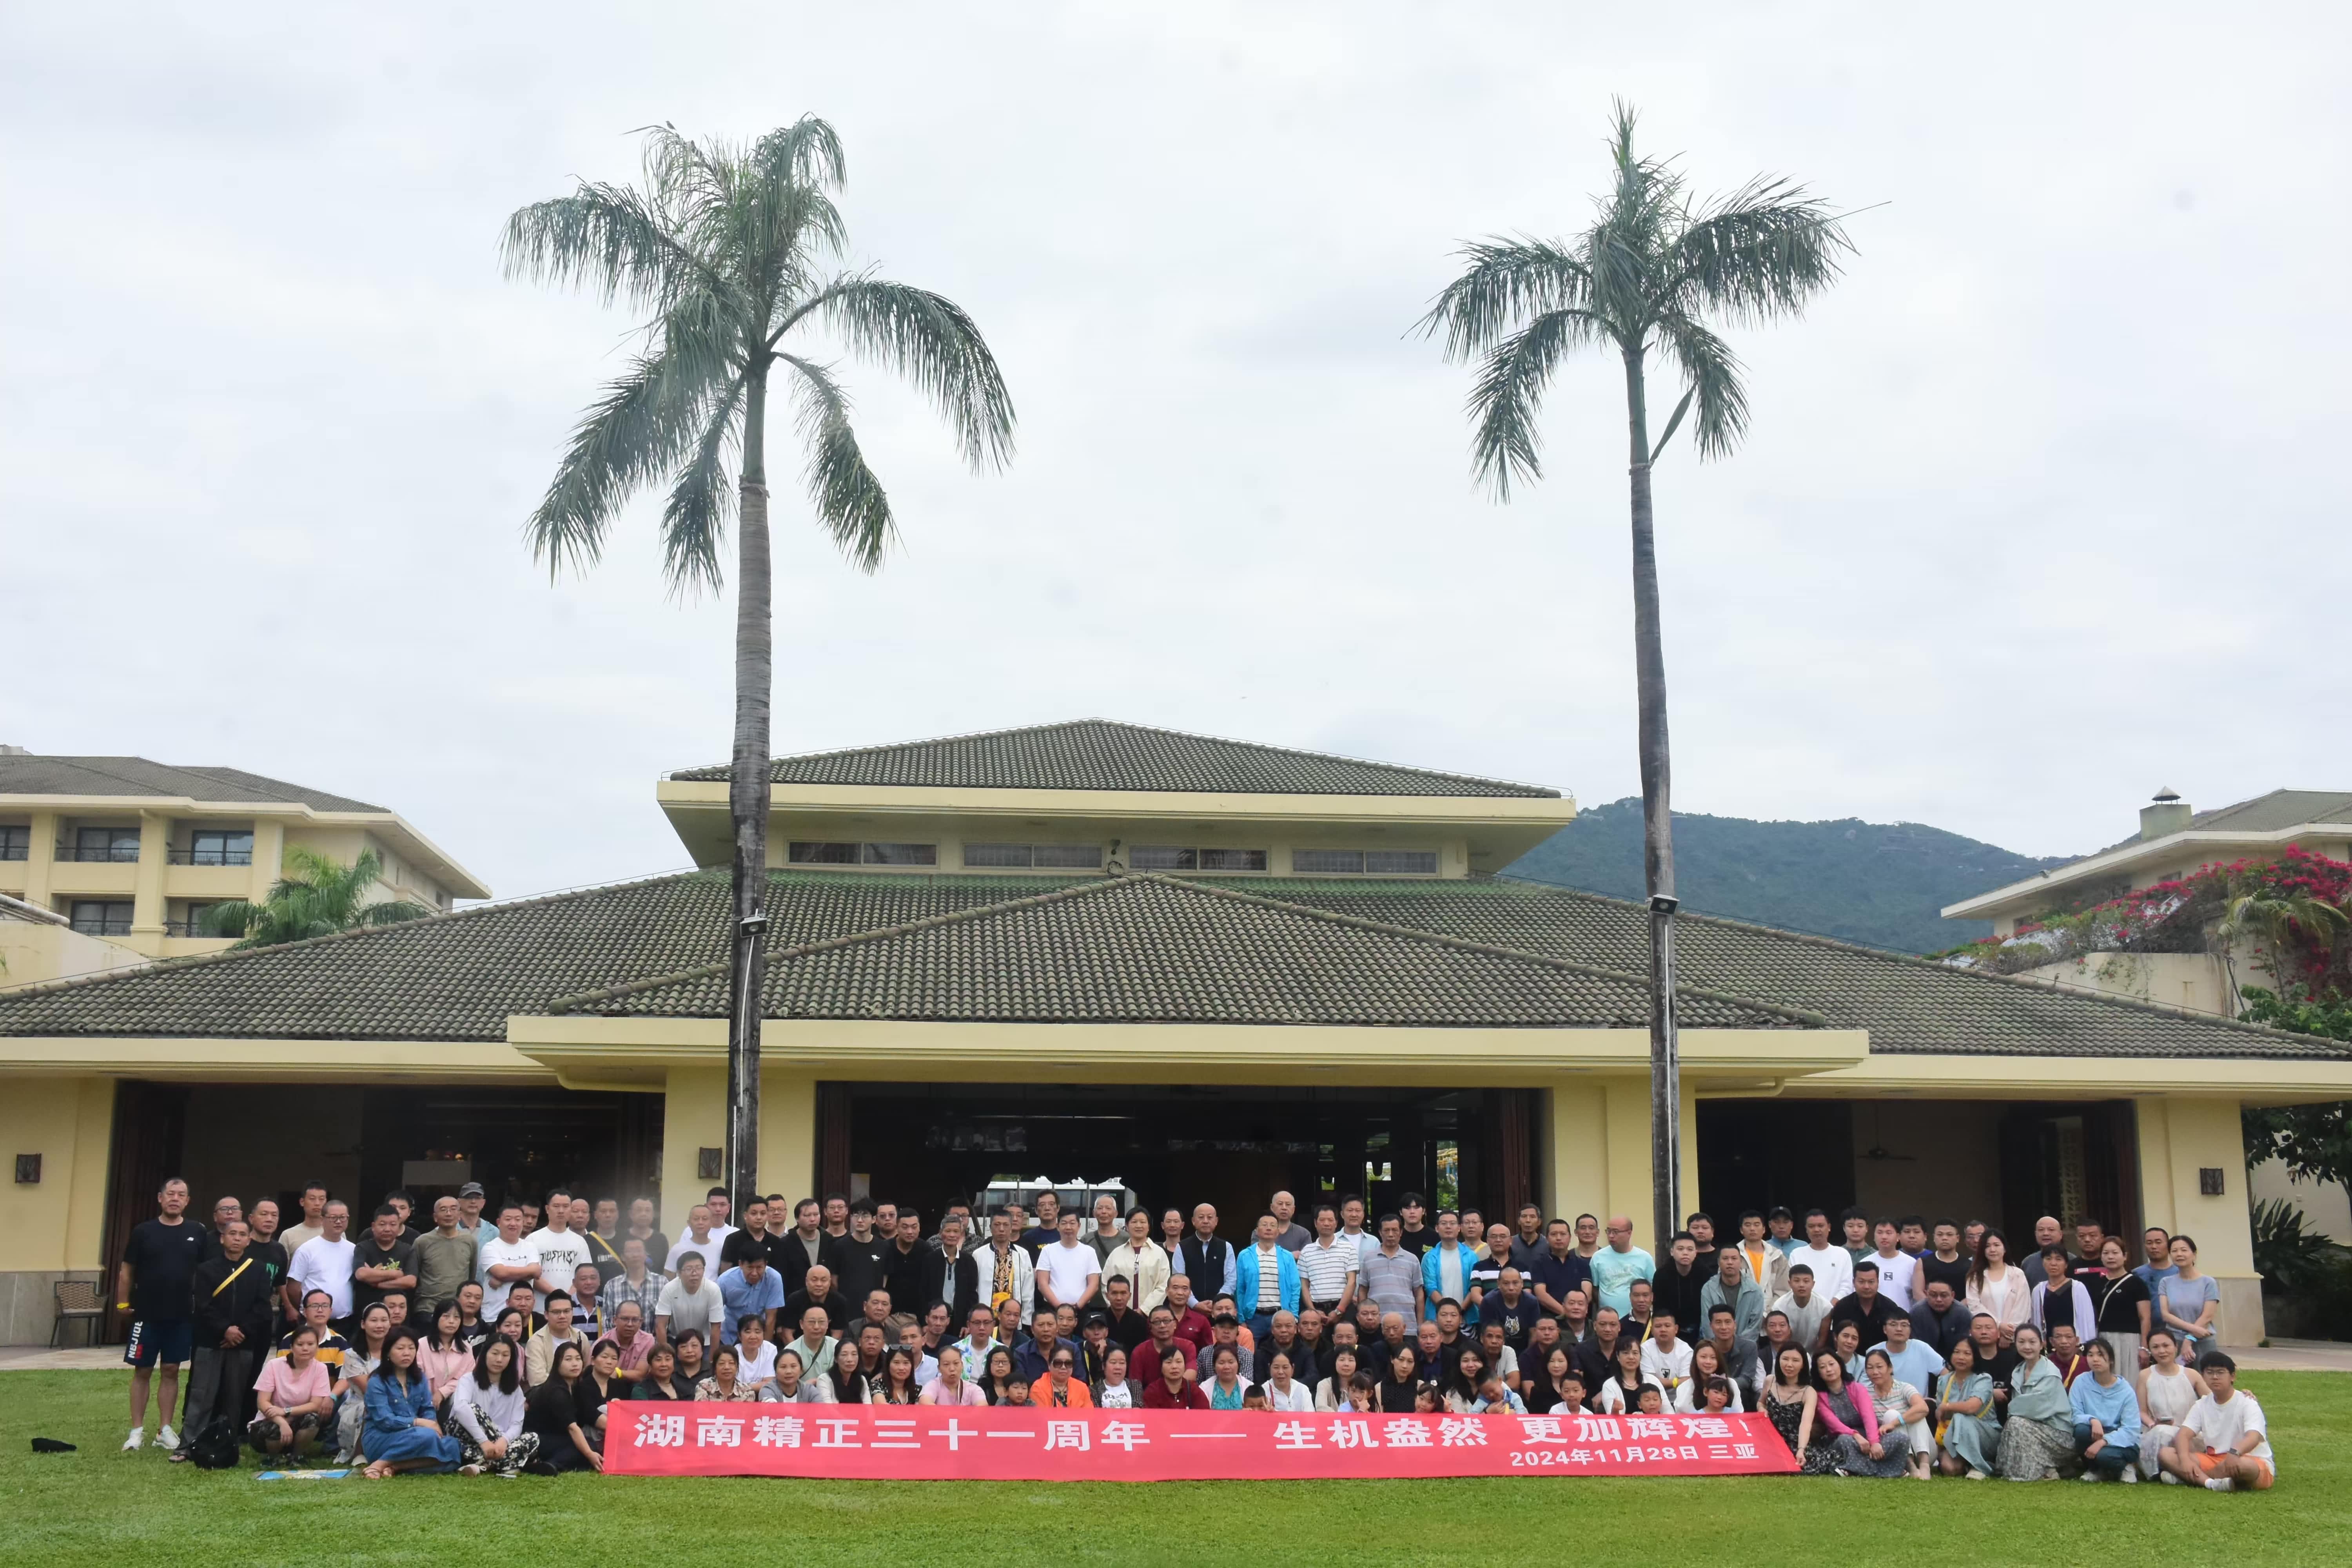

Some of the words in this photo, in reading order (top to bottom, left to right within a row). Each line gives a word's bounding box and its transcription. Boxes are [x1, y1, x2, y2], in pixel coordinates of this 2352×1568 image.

[634, 1414, 1150, 1451] 湖南精正三十一周年
[1273, 1417, 1488, 1449] 生机盎然
[1517, 1417, 1752, 1445] 更加辉煌!
[1510, 1446, 1699, 1466] 2024年11月28日
[1708, 1443, 1759, 1459] 三亚
